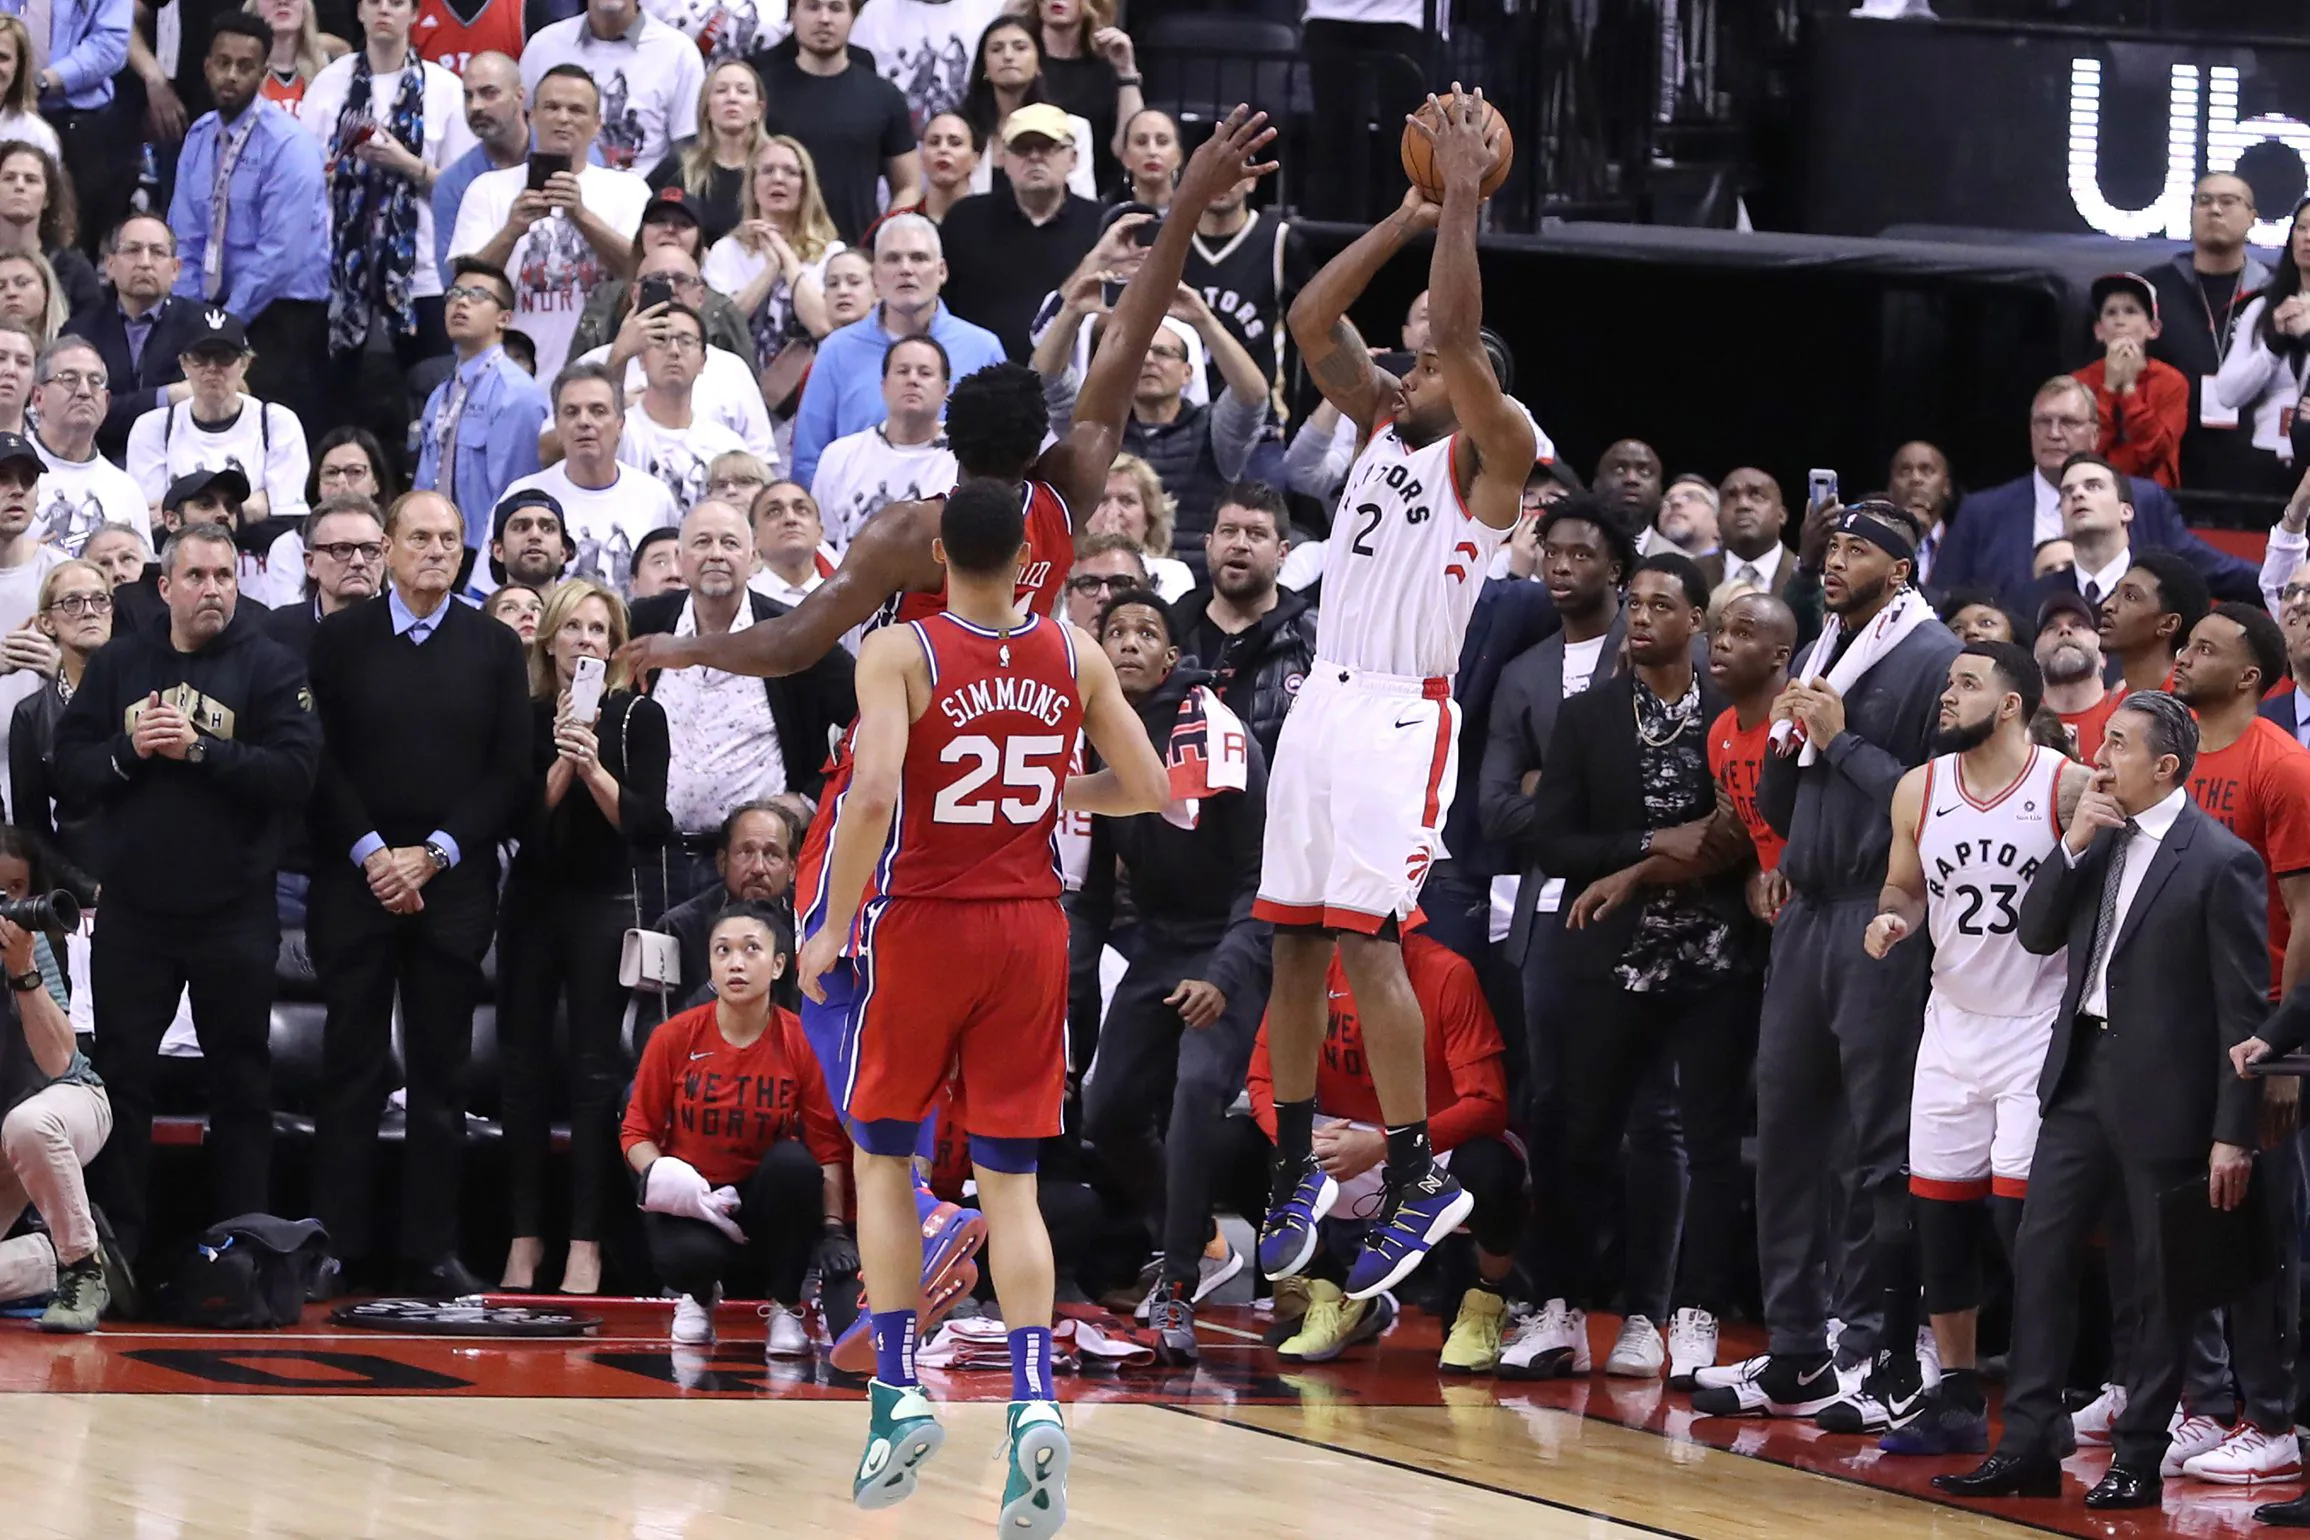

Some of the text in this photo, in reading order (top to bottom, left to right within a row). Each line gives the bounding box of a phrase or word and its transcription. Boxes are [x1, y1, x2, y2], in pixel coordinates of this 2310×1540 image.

[1203, 286, 1264, 339] TORS
[1351, 502, 1382, 557] 2
[940, 676, 1070, 728] SIMMONS
[933, 734, 1065, 825] 25
[2194, 777, 2238, 812] THE
[1928, 838, 2041, 899] RAPTOR
[1955, 883, 2019, 936] 23
[684, 1070, 794, 1109] WE THE
